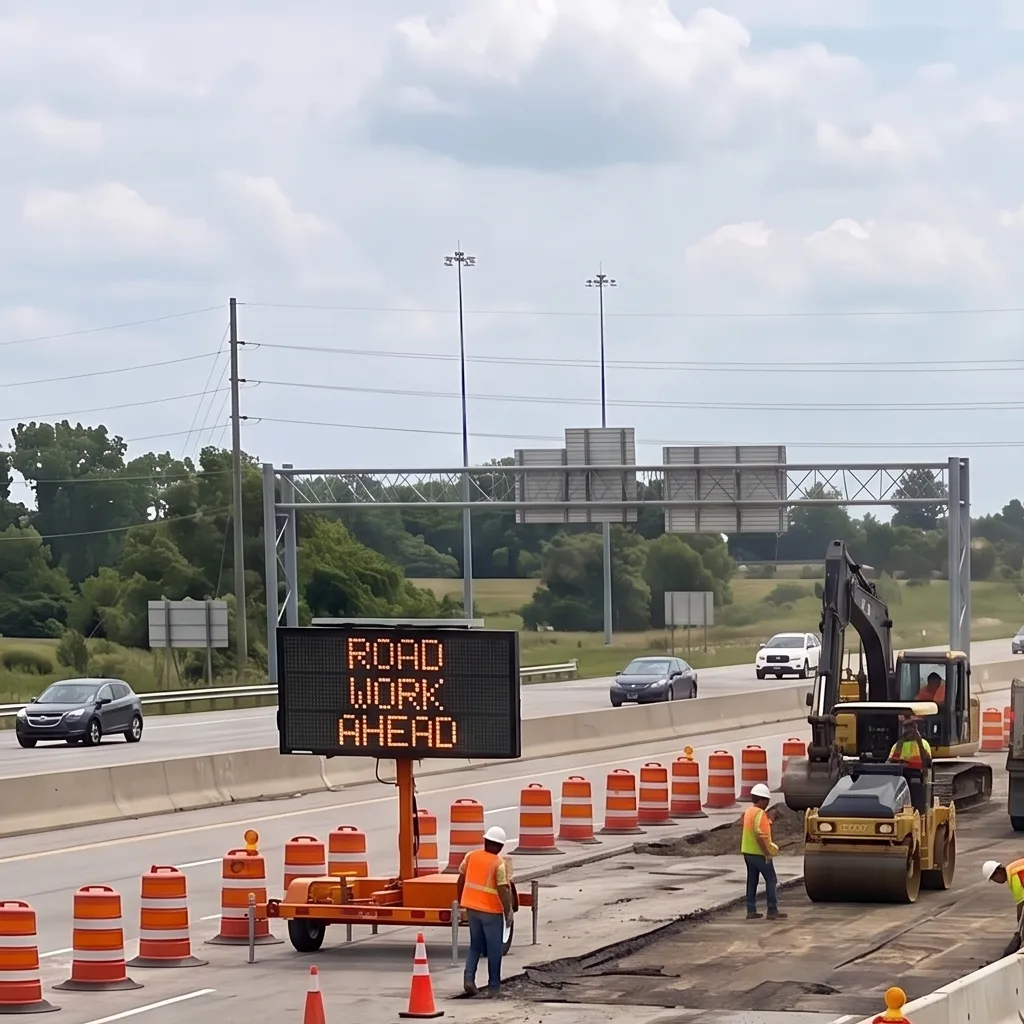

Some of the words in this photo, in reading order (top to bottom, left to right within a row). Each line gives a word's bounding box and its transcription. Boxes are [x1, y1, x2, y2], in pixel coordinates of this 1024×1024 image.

[347, 637, 444, 671] ROAD
[349, 676, 444, 711] WORK
[337, 714, 457, 748] AHEAD
